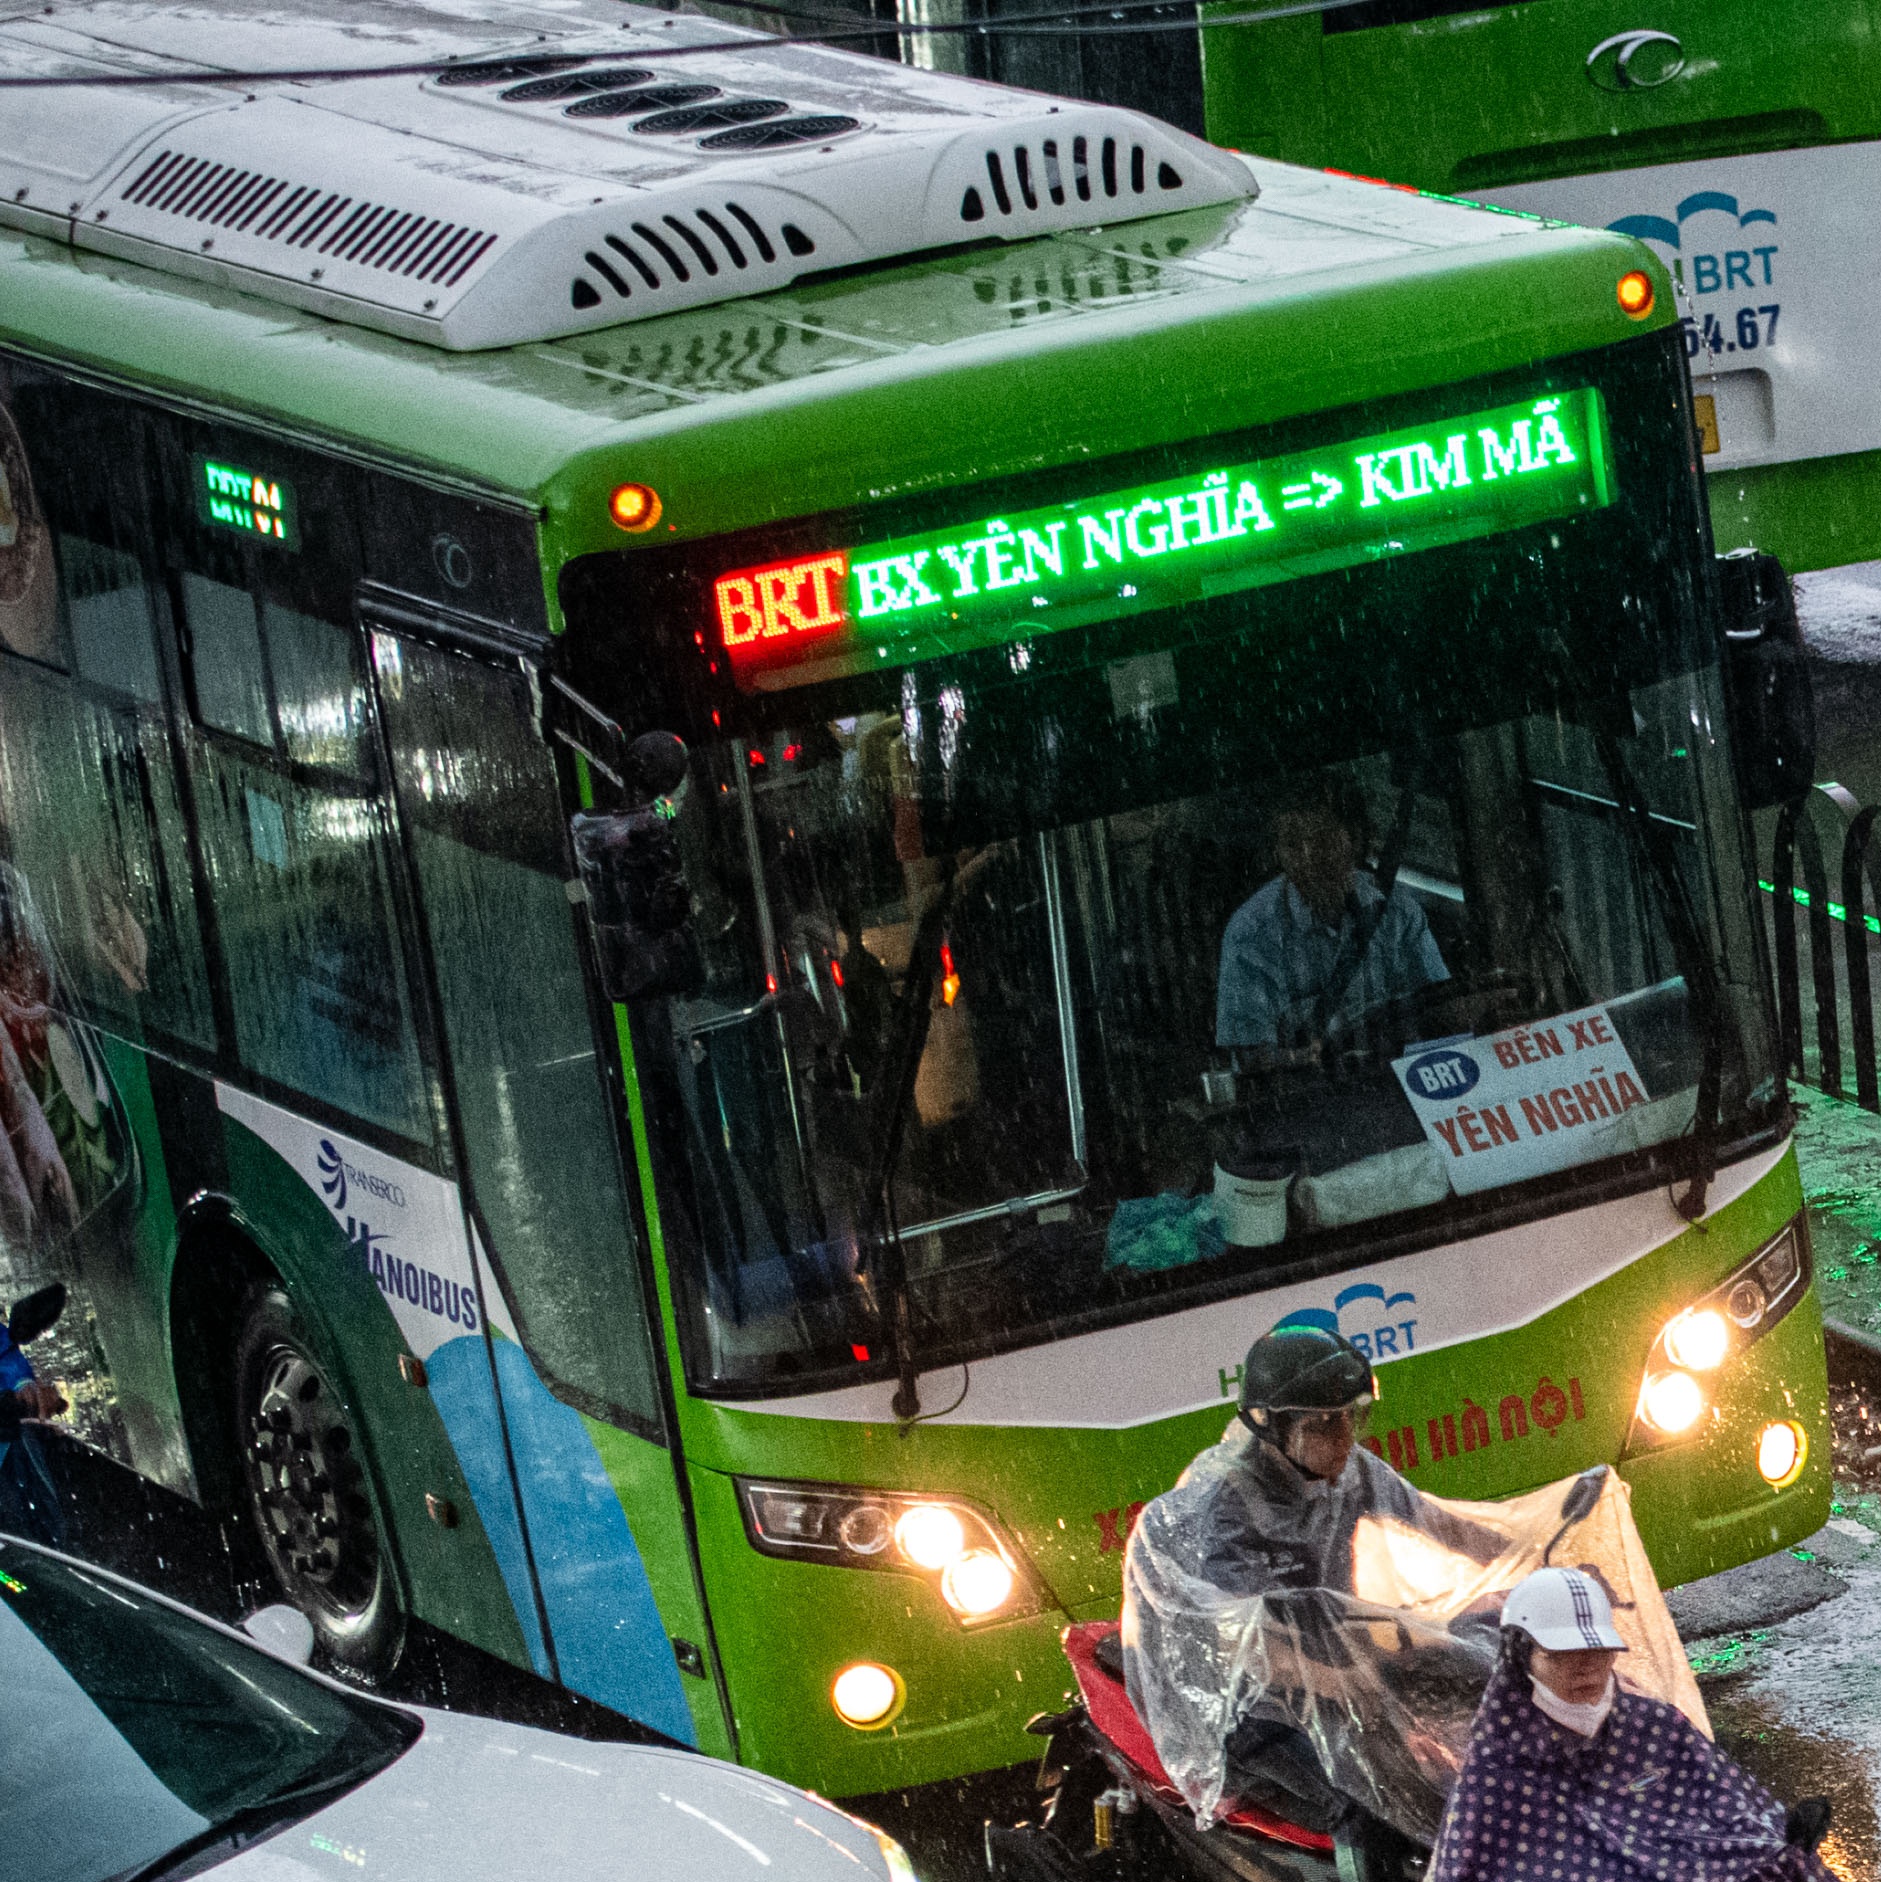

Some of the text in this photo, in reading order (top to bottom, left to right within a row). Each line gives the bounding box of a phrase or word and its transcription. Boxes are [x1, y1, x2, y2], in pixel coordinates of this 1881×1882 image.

[1692, 245, 1779, 295] BRT
[715, 556, 846, 647] BRT
[937, 518, 1066, 599] YÊN
[1076, 471, 1275, 570] NGHĨA
[1354, 434, 1473, 508] KIM
[1491, 1014, 1615, 1071] BẾN XE
[1415, 1056, 1469, 1094] BRT
[1431, 1065, 1649, 1158] YÊN NGHĨA
[343, 1162, 406, 1209] TRANSERCO
[346, 1214, 478, 1331] HANOIBUS
[1350, 1318, 1418, 1362] BRT
